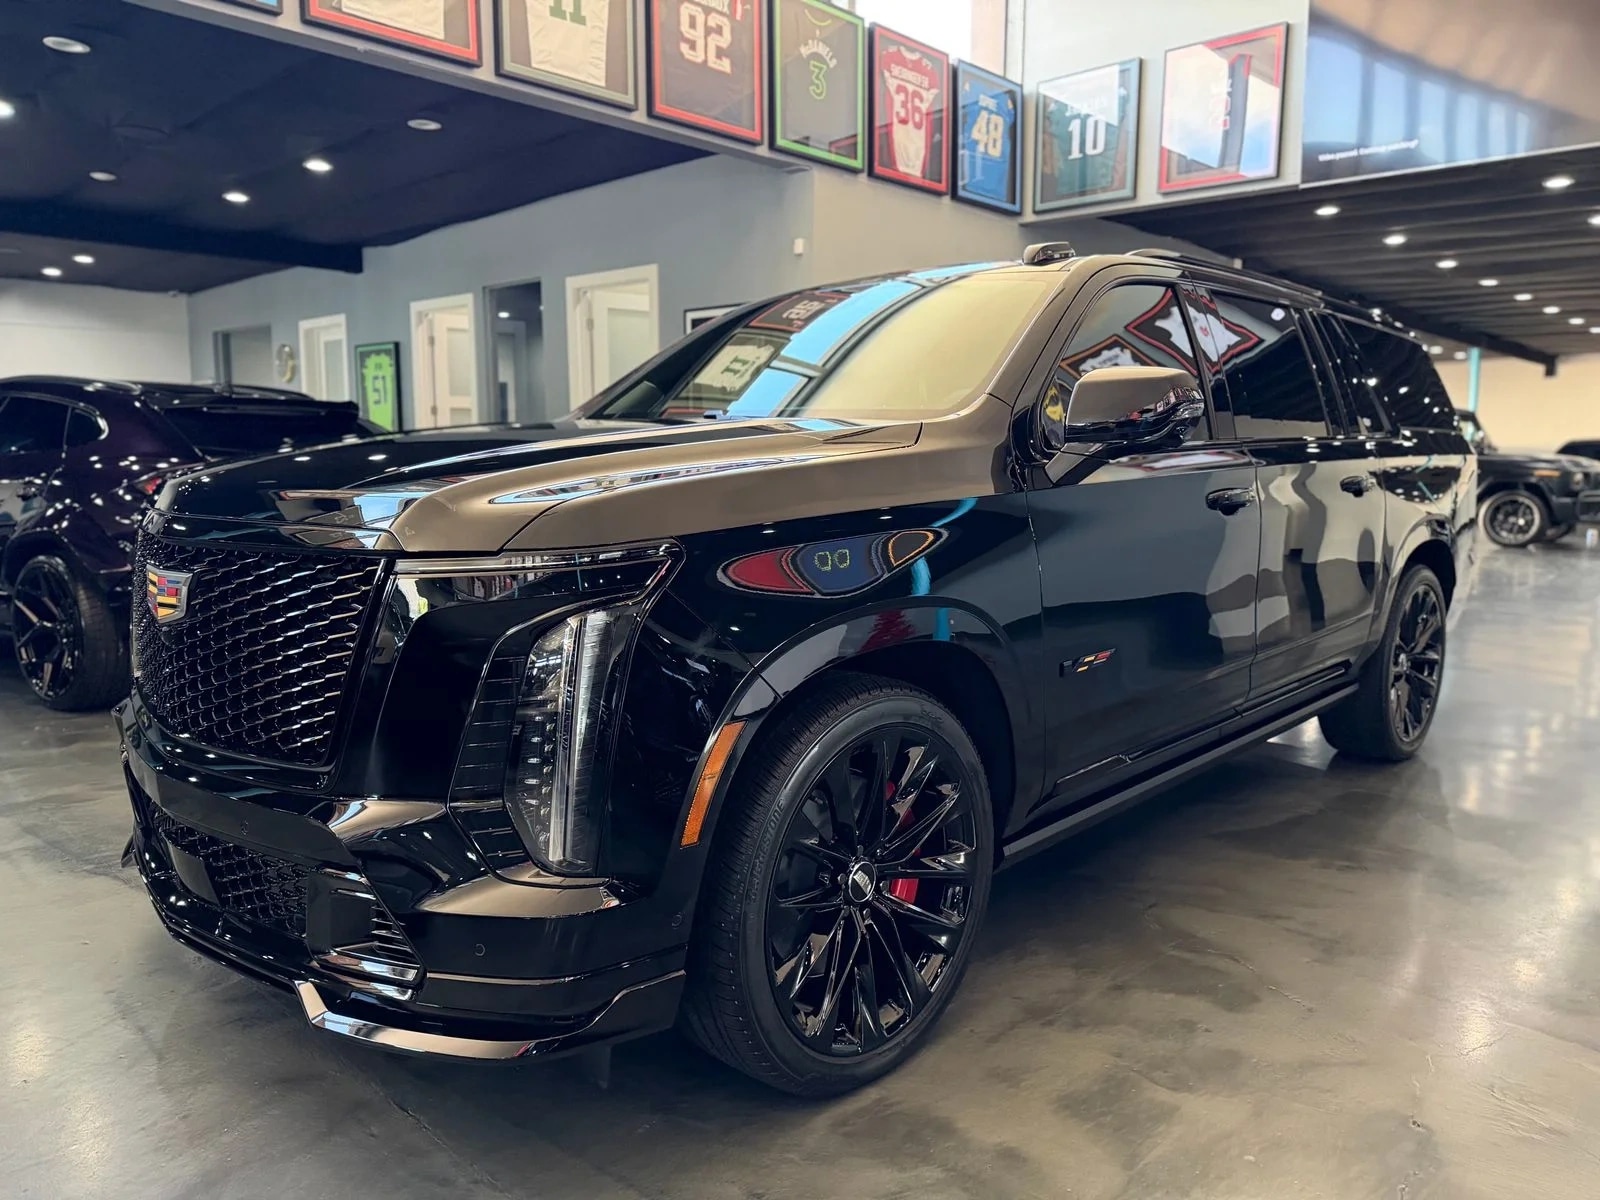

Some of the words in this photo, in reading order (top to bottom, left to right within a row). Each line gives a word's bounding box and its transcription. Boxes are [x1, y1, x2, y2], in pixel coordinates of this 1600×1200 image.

[680, 2, 732, 74] 92
[809, 60, 827, 100] 3
[895, 84, 924, 130] 36
[971, 110, 1004, 158] 48
[1067, 117, 1106, 160] 10
[372, 375, 388, 405] 51
